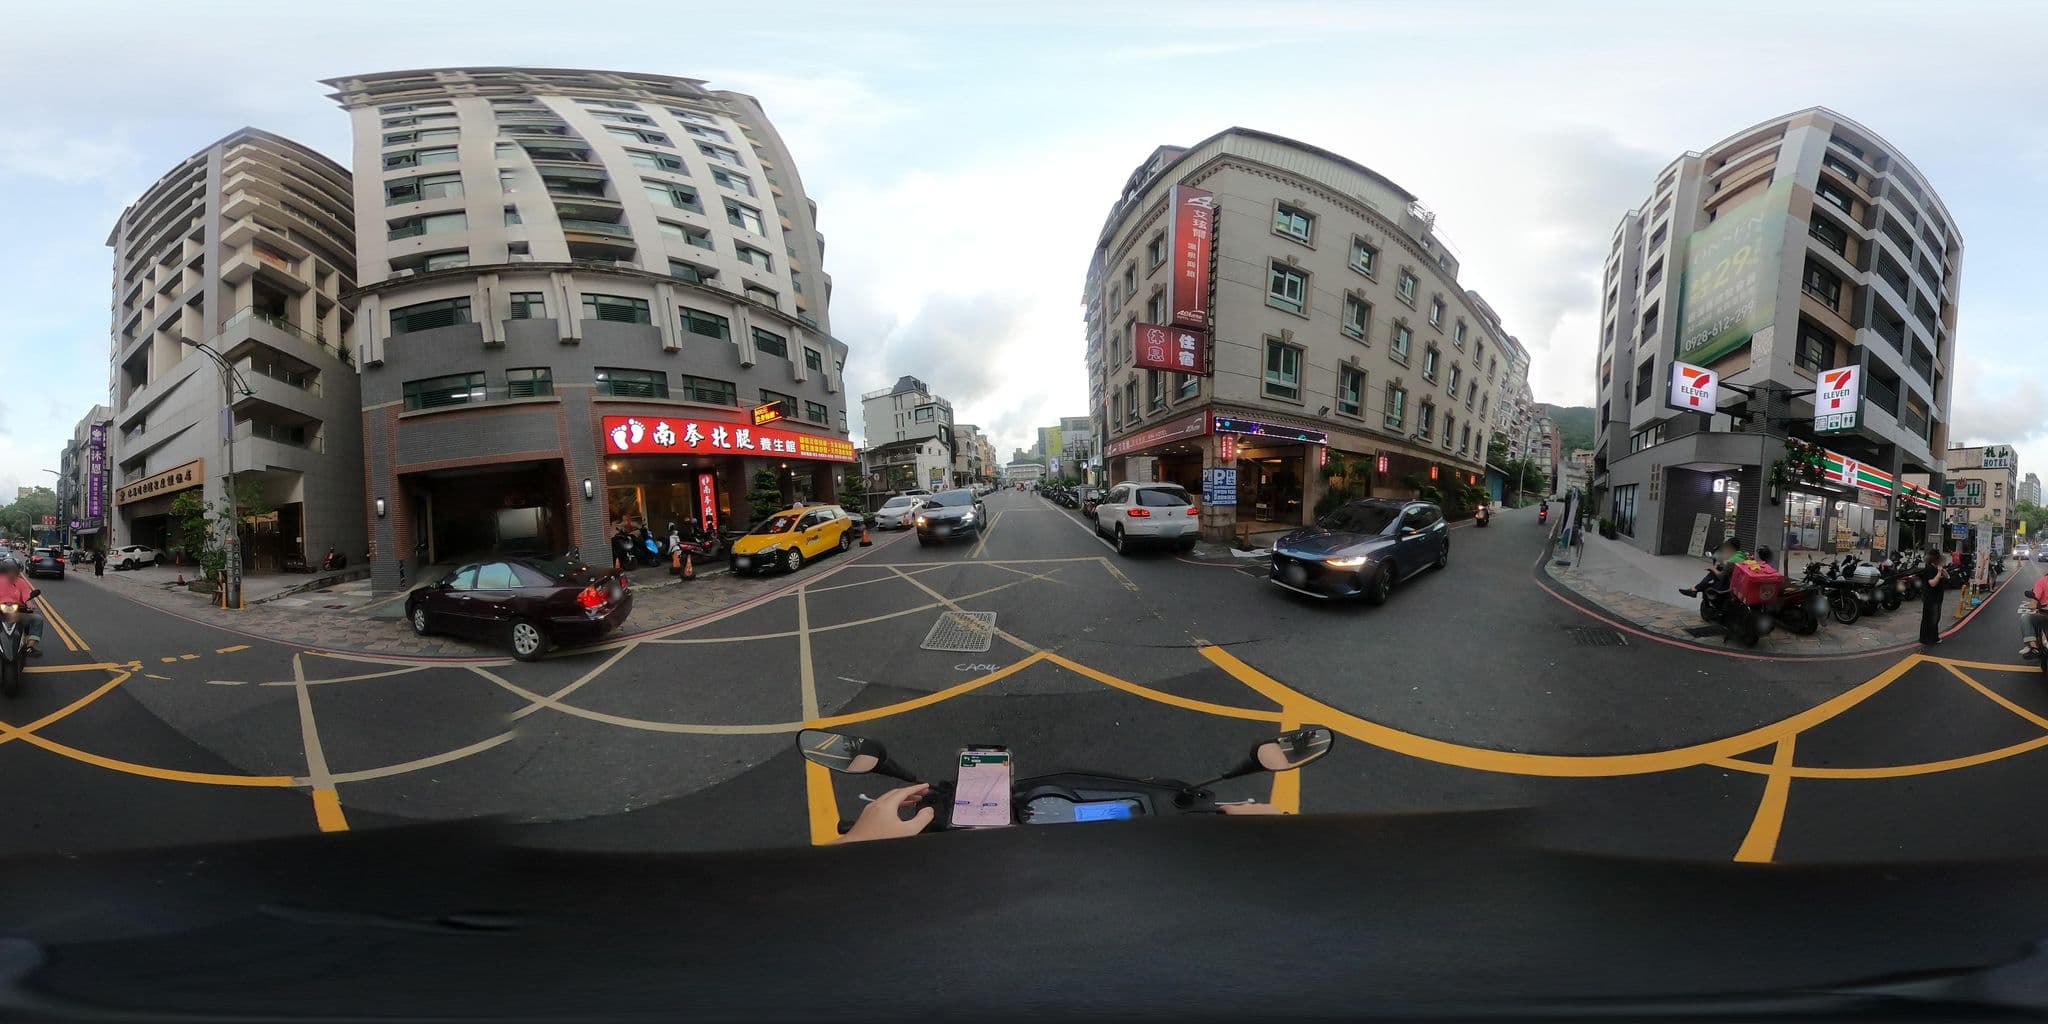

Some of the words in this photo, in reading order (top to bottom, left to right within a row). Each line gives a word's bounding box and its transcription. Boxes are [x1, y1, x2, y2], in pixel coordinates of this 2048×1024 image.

[1146, 328, 1165, 362] 休息
[1178, 333, 1196, 367] 住宿
[652, 421, 755, 450] 南拳北腿
[760, 436, 797, 453] 養生館
[1984, 458, 2008, 467] HOTEL
